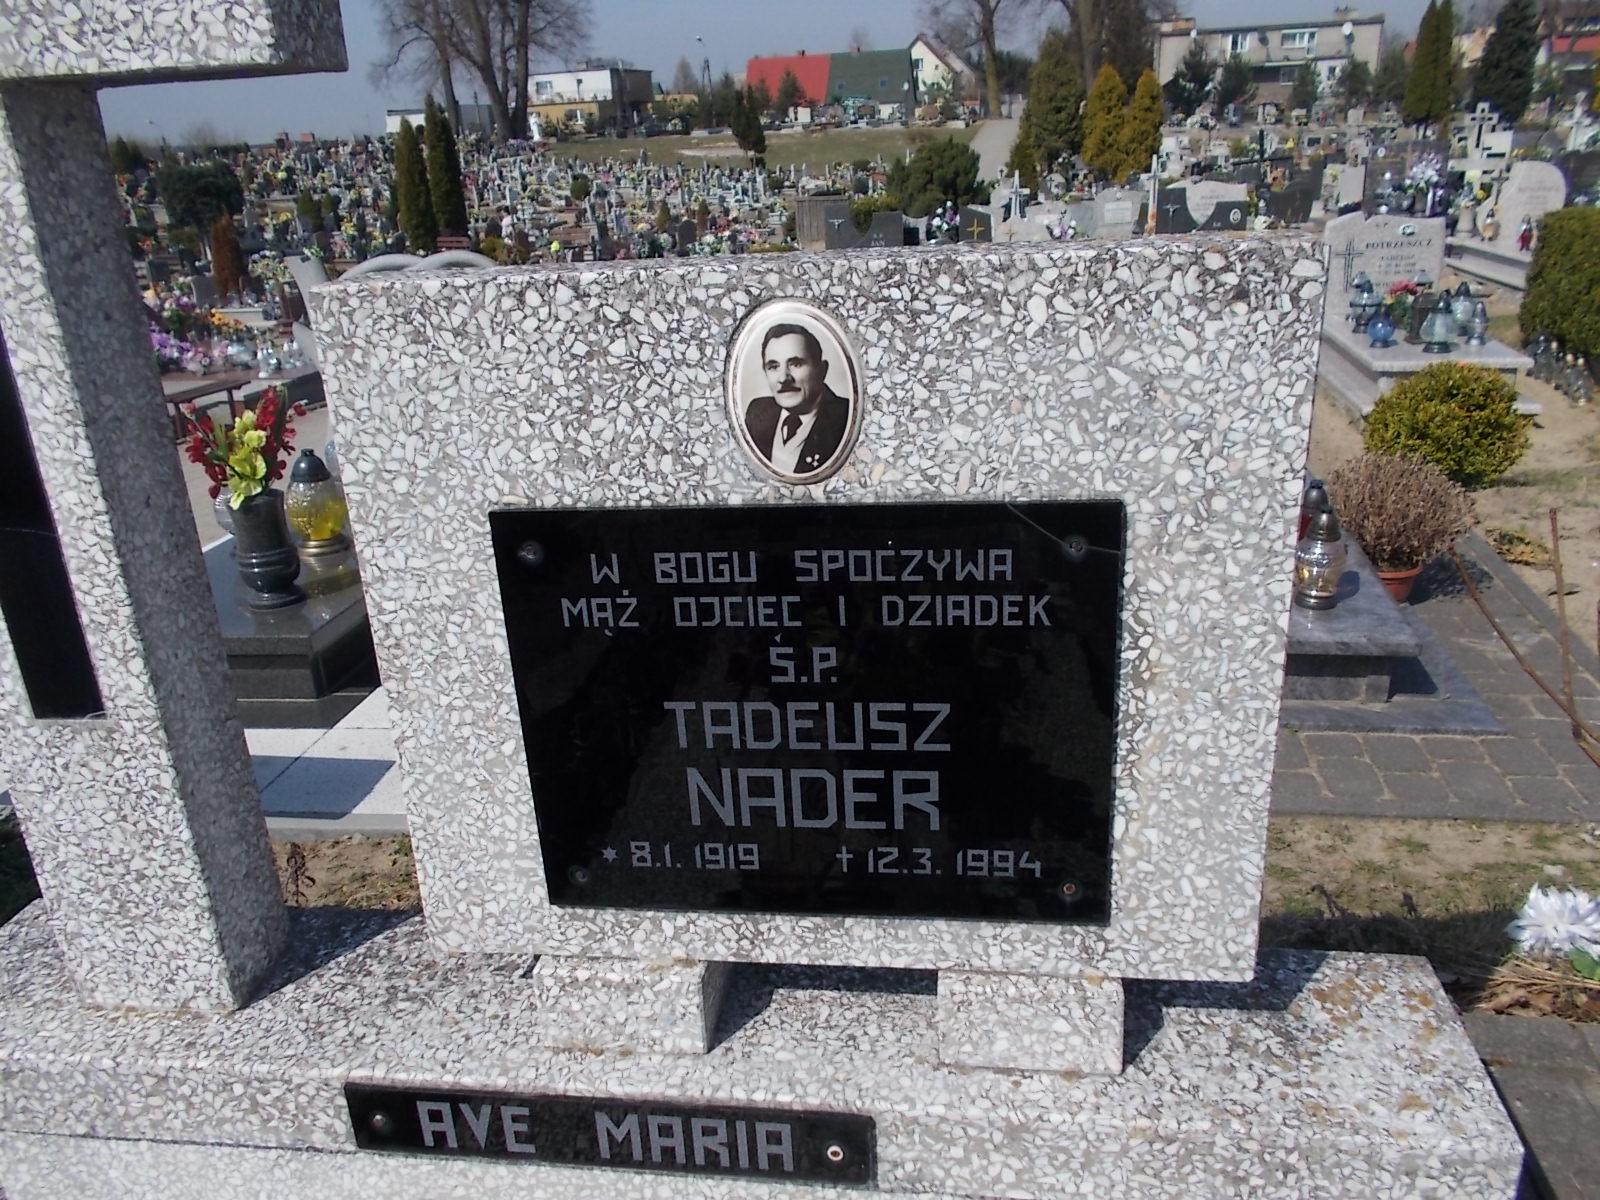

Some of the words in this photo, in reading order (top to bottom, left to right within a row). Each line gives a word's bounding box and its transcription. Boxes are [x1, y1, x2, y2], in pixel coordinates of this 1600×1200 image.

[590, 553, 620, 584] W
[653, 551, 757, 583] BOGU
[794, 549, 1012, 582] SPOCZYWA
[561, 589, 639, 636] MĄŻ
[673, 596, 802, 627] OJCIEC
[838, 595, 846, 626] I
[882, 595, 1051, 626] DZIADEK
[769, 632, 838, 683] Ś.P.
[663, 701, 951, 751] TADEUSZ
[686, 767, 940, 830] NADER
[629, 841, 682, 867] 8.1.
[694, 842, 760, 870] 1919
[867, 847, 942, 874] 12.3.
[956, 849, 1041, 877] 1994
[416, 1101, 536, 1154] AVE
[594, 1111, 794, 1172] MARIA
